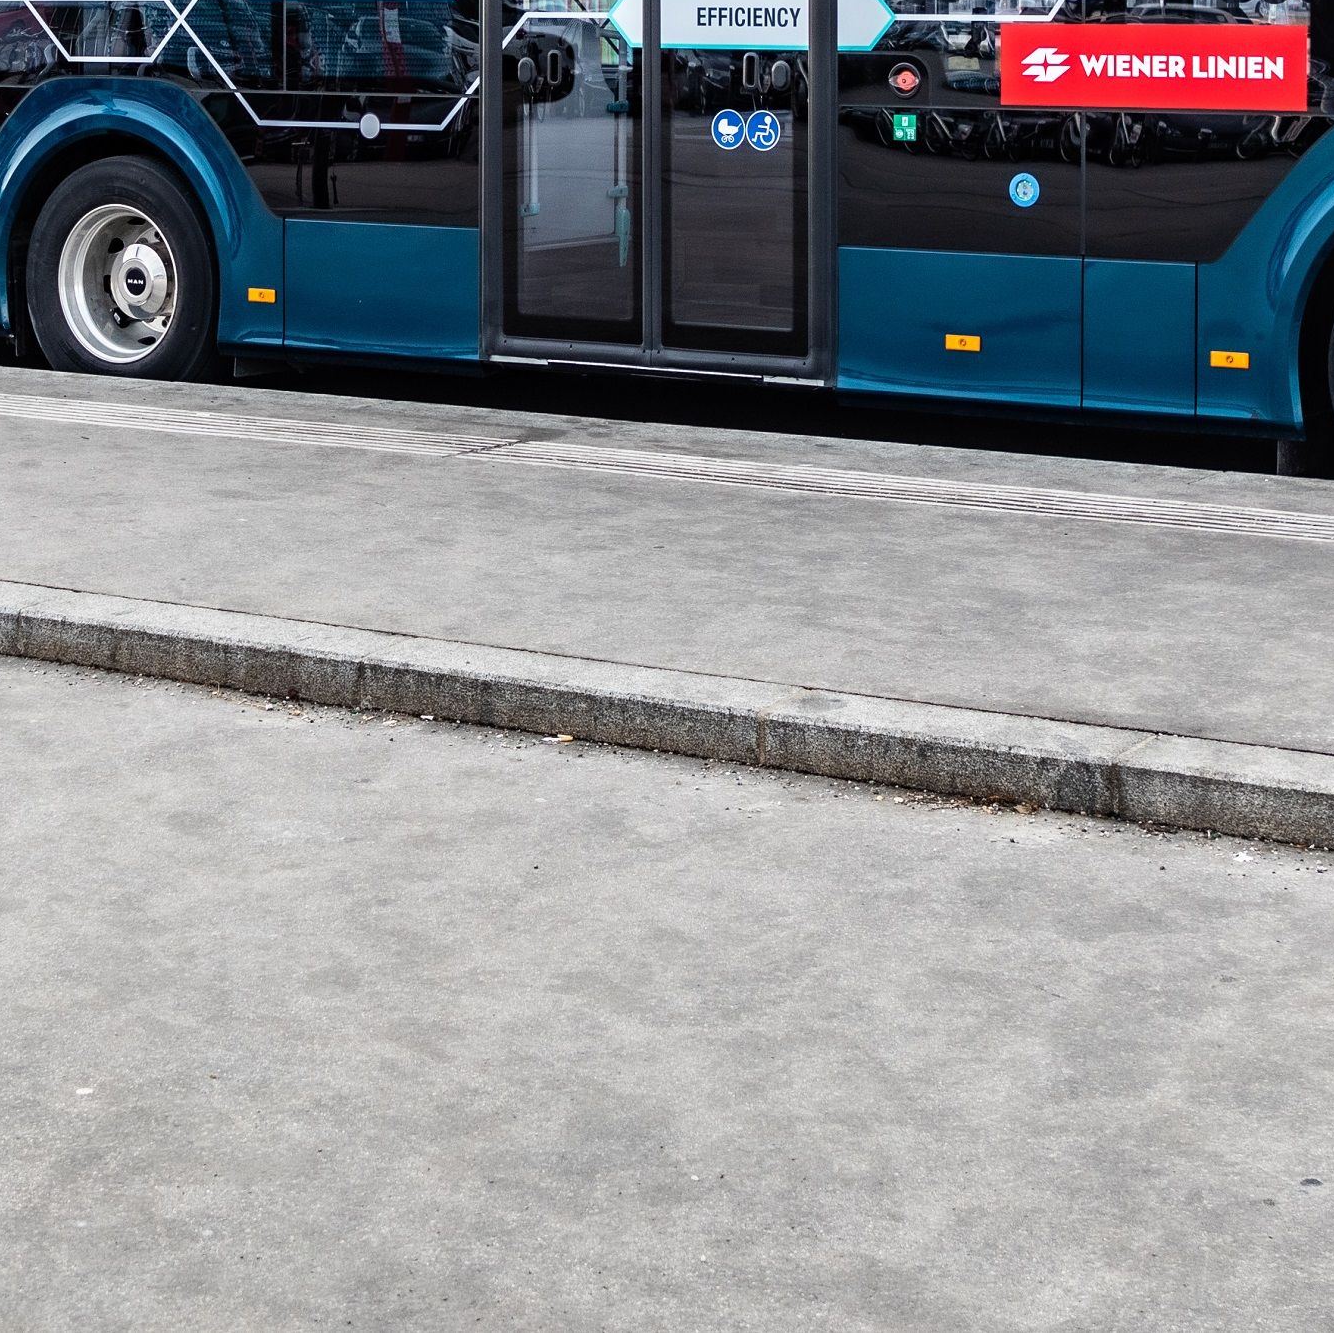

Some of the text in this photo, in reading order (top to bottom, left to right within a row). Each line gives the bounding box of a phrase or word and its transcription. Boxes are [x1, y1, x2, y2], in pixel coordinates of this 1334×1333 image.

[697, 7, 801, 27] EFFICIENCY
[1079, 54, 1284, 80] WIENER LINIEN
